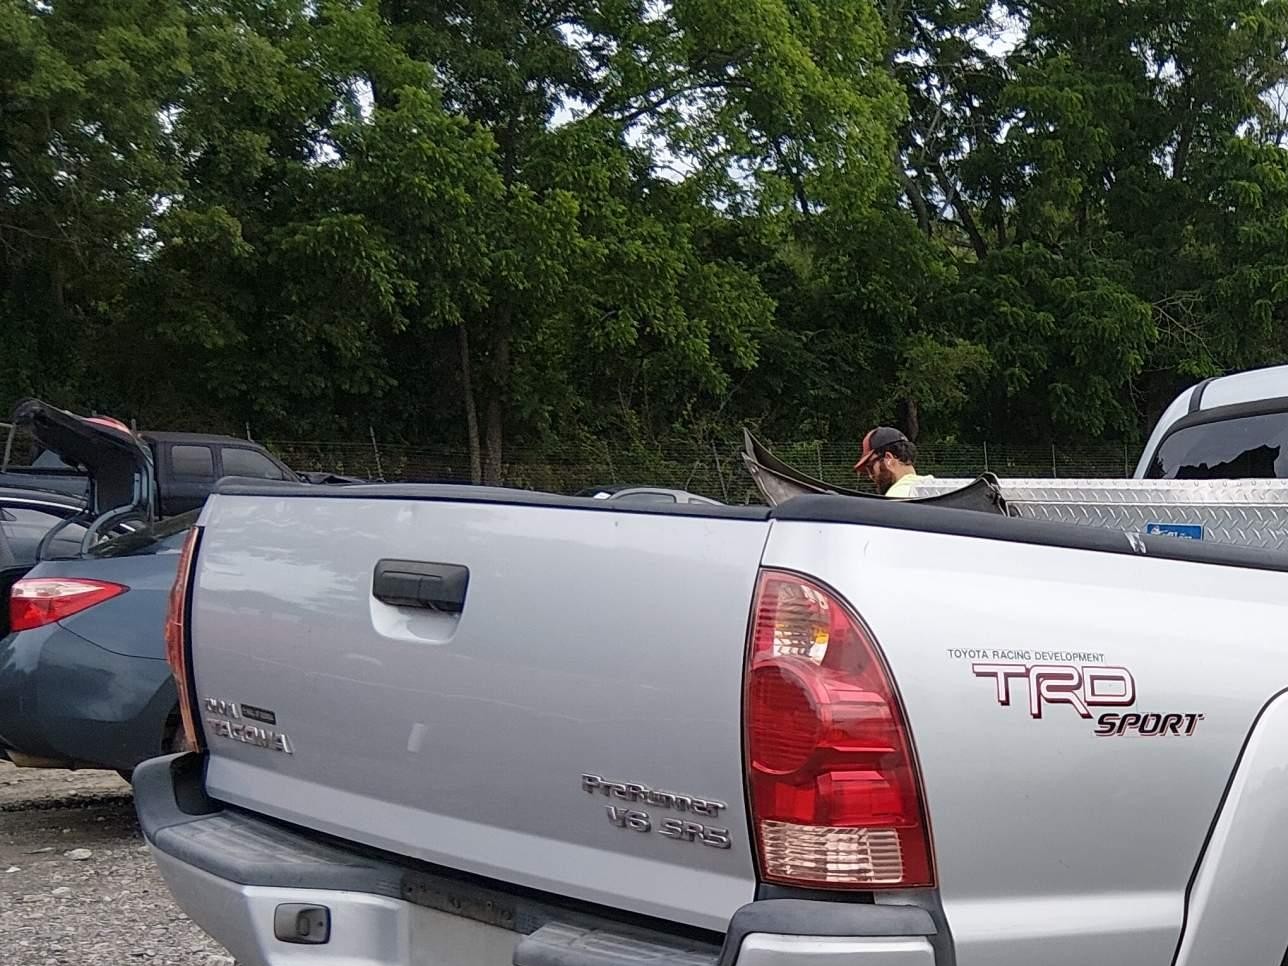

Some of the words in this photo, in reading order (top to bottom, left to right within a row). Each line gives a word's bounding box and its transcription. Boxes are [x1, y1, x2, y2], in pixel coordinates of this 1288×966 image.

[948, 649, 989, 659] TOYOTA
[993, 650, 1031, 661] RACING
[1034, 651, 1104, 662] DEVELOPMENT
[971, 663, 1137, 719] TRD
[1094, 713, 1205, 737] SPORT
[605, 805, 651, 833] V6
[658, 817, 732, 850] SR5
